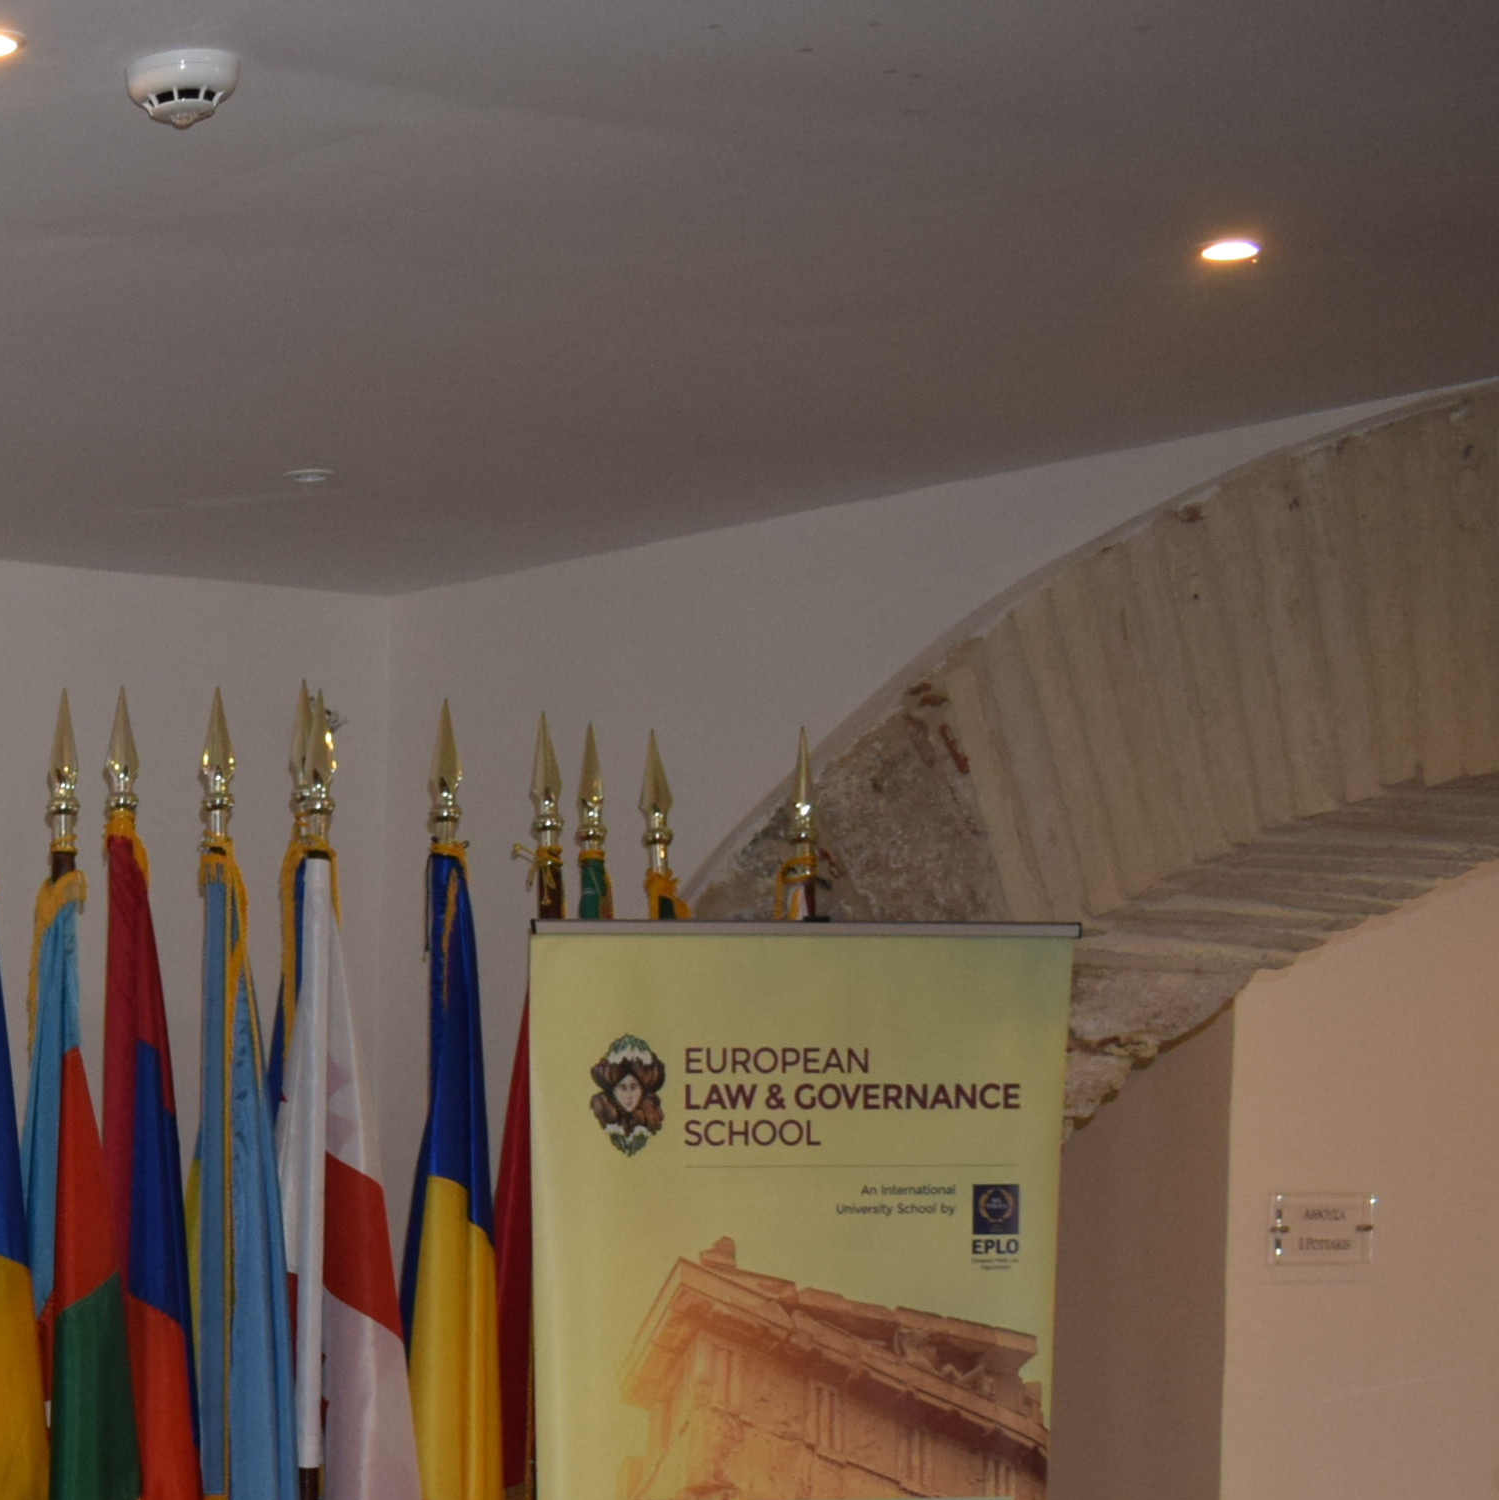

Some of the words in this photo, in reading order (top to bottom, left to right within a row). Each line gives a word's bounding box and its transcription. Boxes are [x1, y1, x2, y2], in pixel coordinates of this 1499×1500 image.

[683, 1047, 871, 1075] EUROPEAN
[685, 1084, 757, 1111] LAW
[765, 1084, 787, 1111] &
[794, 1083, 1021, 1111] GOVERNANCE
[683, 1119, 821, 1148] SCHOOL
[860, 1184, 878, 1196] An
[881, 1183, 956, 1196] International
[836, 1204, 893, 1217] University
[896, 1203, 938, 1216] School
[941, 1203, 956, 1218] by
[972, 1239, 1020, 1255] EPLO
